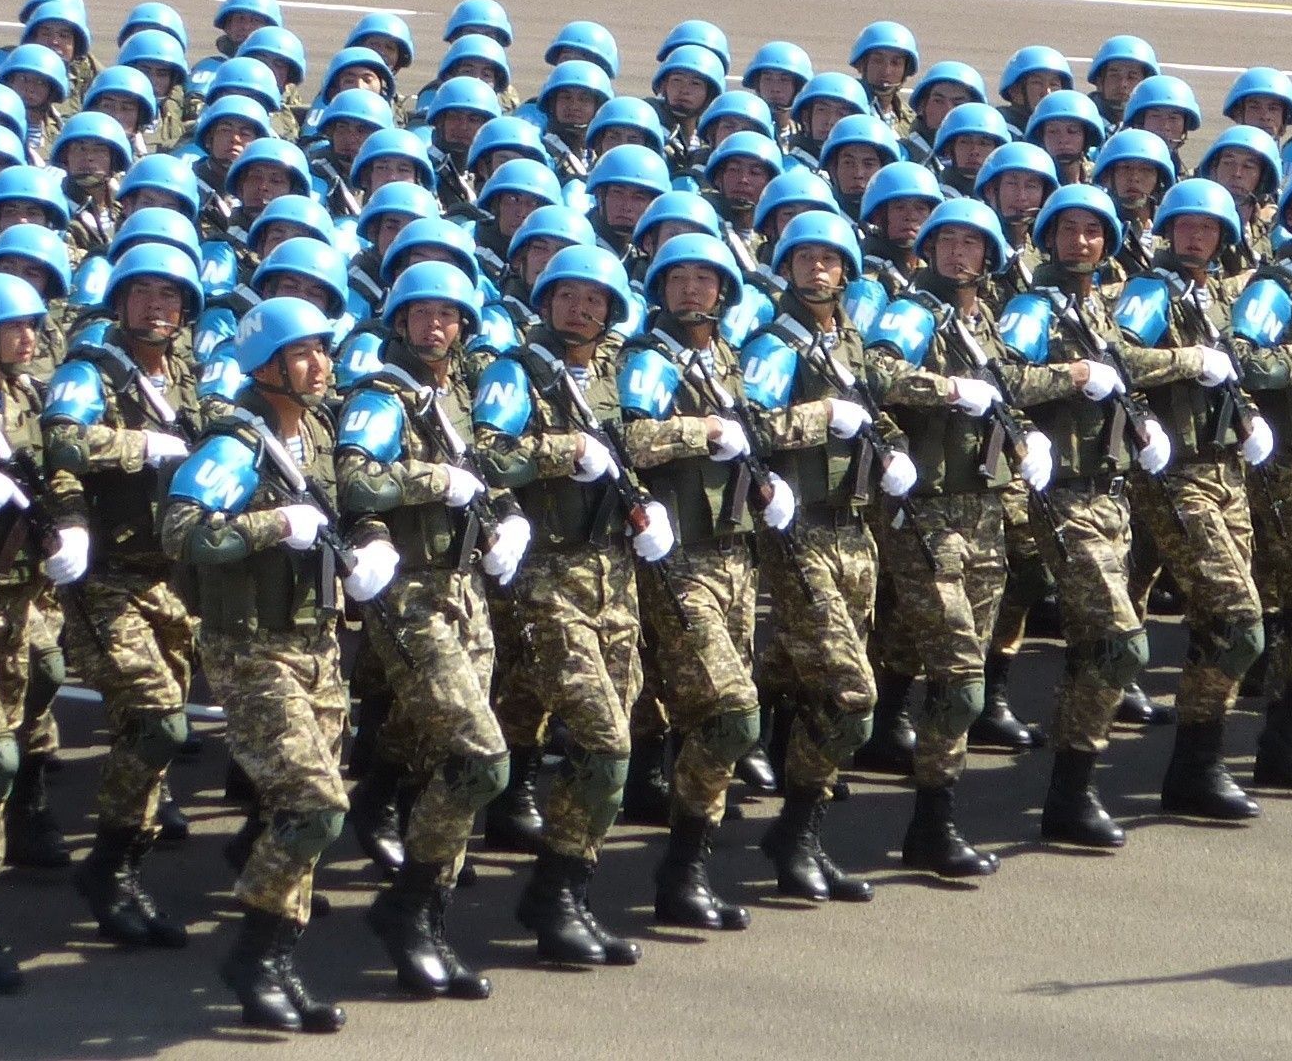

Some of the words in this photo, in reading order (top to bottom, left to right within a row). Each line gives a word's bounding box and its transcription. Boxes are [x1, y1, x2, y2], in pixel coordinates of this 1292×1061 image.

[1245, 298, 1284, 343] UN
[630, 368, 673, 414] UN
[744, 357, 791, 400] UN
[195, 459, 245, 509] UN
